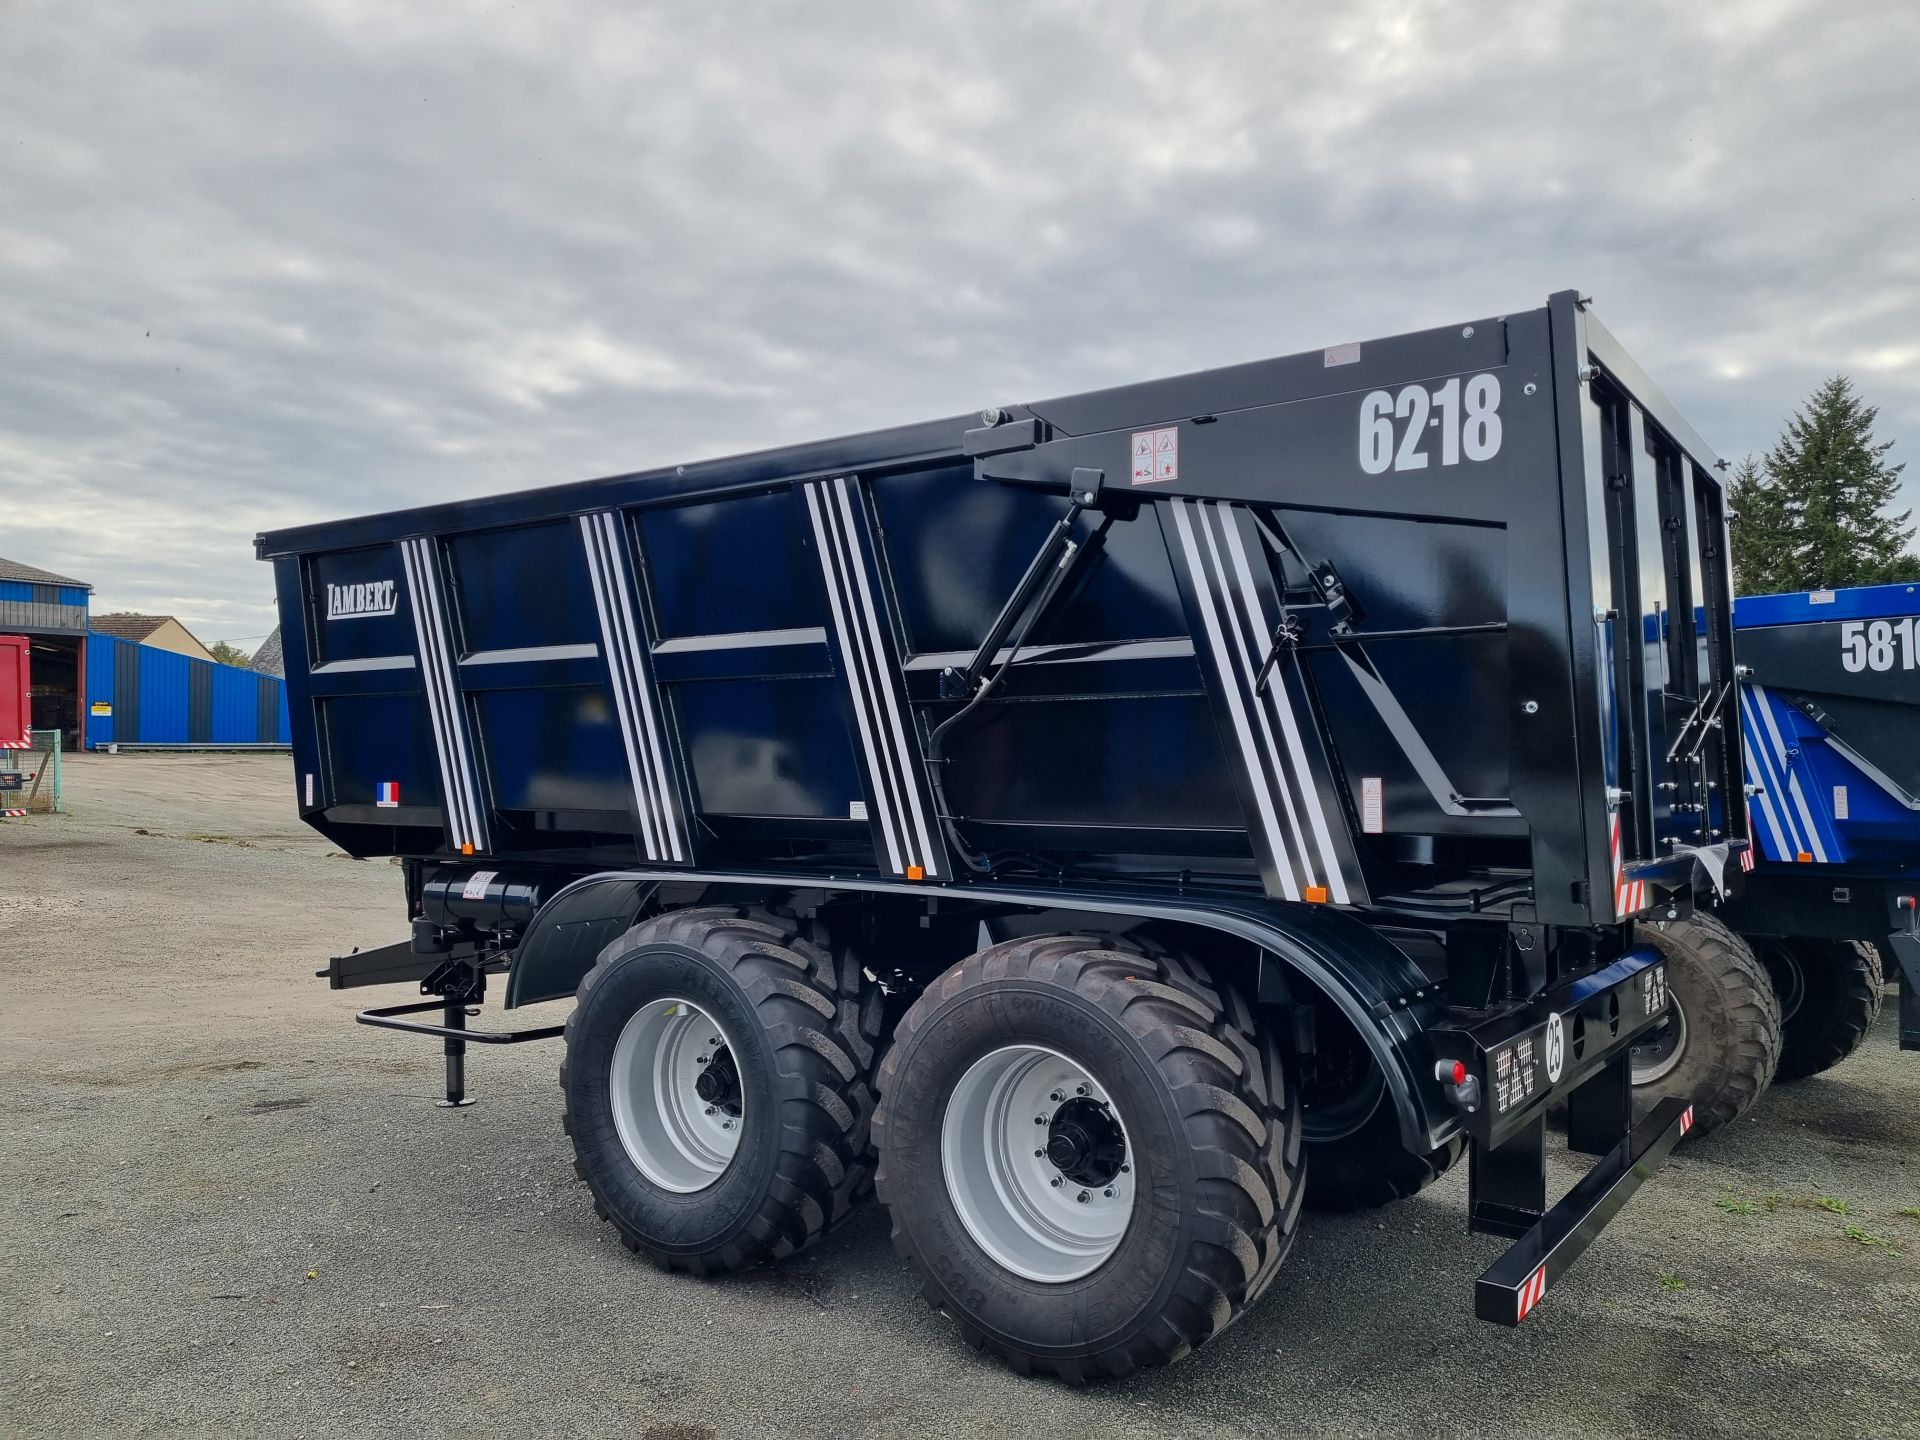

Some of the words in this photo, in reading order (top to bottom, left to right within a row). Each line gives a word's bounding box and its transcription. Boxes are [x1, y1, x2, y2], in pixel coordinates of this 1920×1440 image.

[1359, 374, 1503, 474] 62-18
[327, 580, 398, 620] LAMBERT
[1841, 618, 1920, 673] 58-1
[1548, 1019, 1561, 1074] 25
